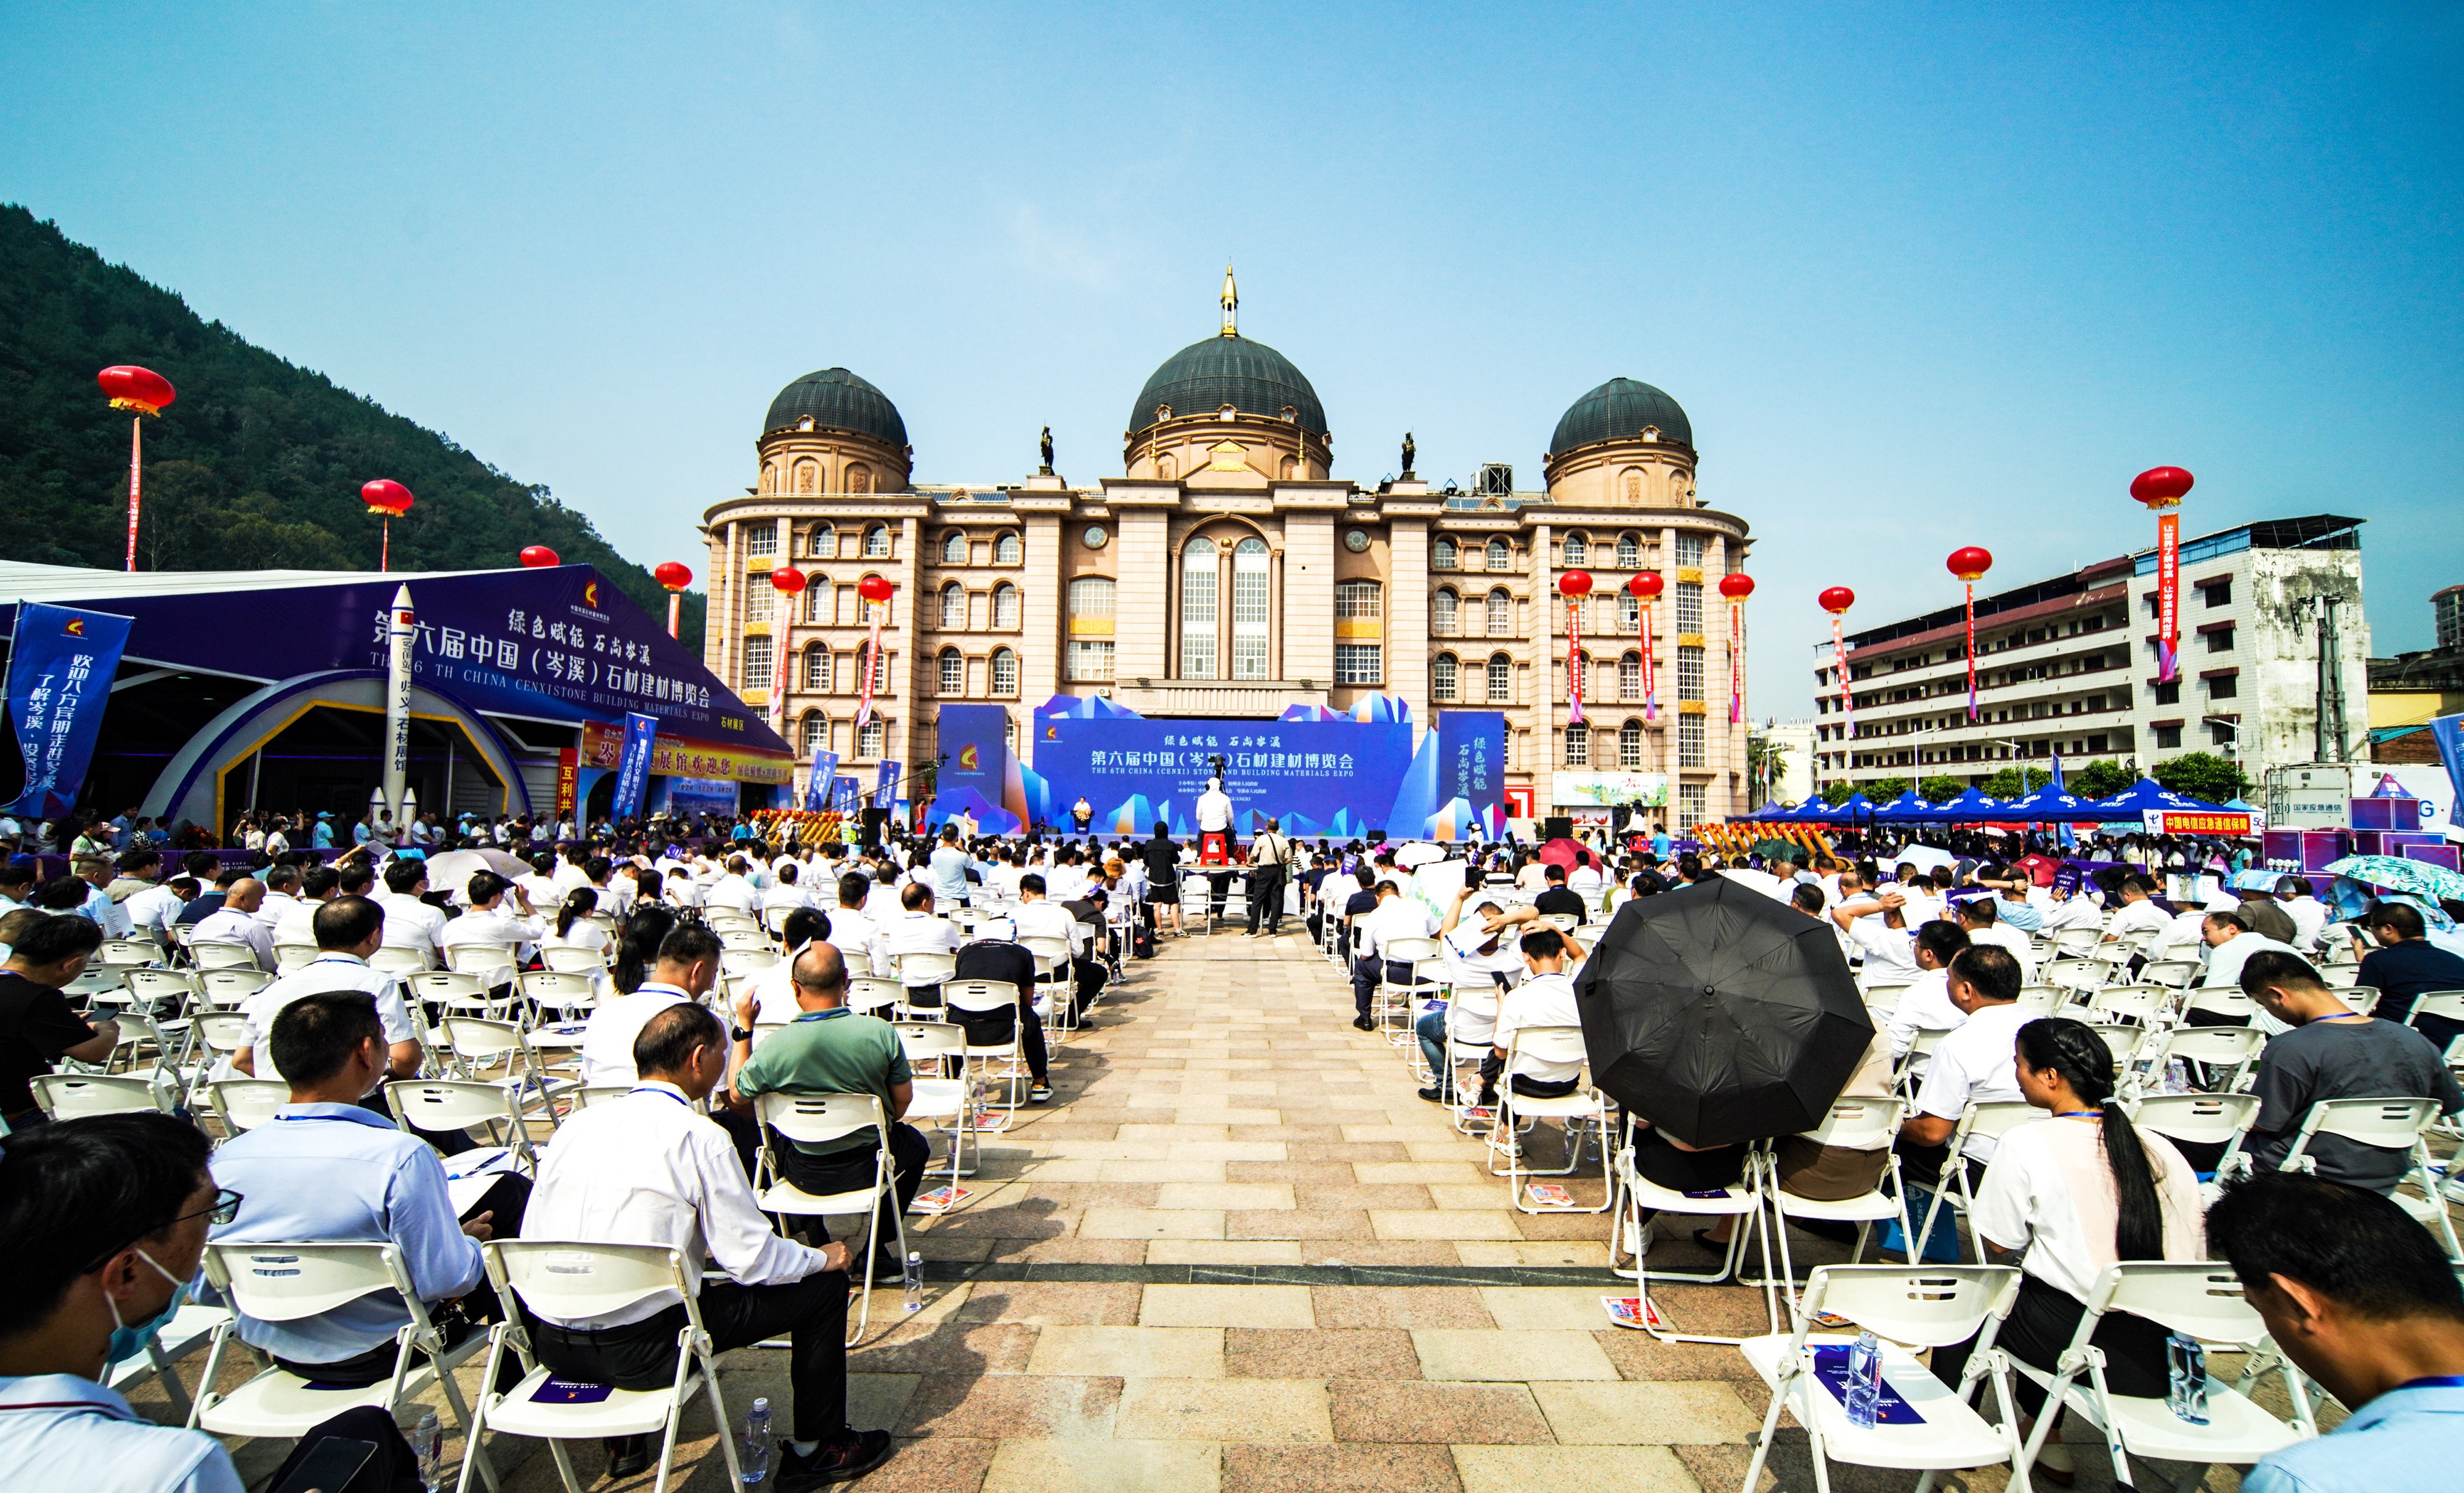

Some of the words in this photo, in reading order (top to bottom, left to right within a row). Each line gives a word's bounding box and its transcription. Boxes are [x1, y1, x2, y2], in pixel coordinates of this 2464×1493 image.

[508, 608, 585, 649] 绿色赋能
[593, 633, 650, 666] 石尚岑溪
[370, 652, 390, 668] TH
[415, 661, 423, 673] 6
[436, 663, 453, 678] TH
[464, 670, 506, 687] CHINA
[516, 679, 586, 701] CENXISTONE
[593, 693, 639, 710] BUILDING
[644, 702, 687, 718] MATERIALS
[692, 710, 710, 722] EXPO
[721, 716, 745, 731] 石材展区
[1164, 735, 1218, 747] 绿色赋能
[1229, 735, 1281, 748] 石尚岑溪
[1457, 743, 1470, 796] 石尚岑溪
[1473, 737, 1487, 790] 绿色赋能
[2166, 816, 2248, 831] 中国电信应急通信保障
